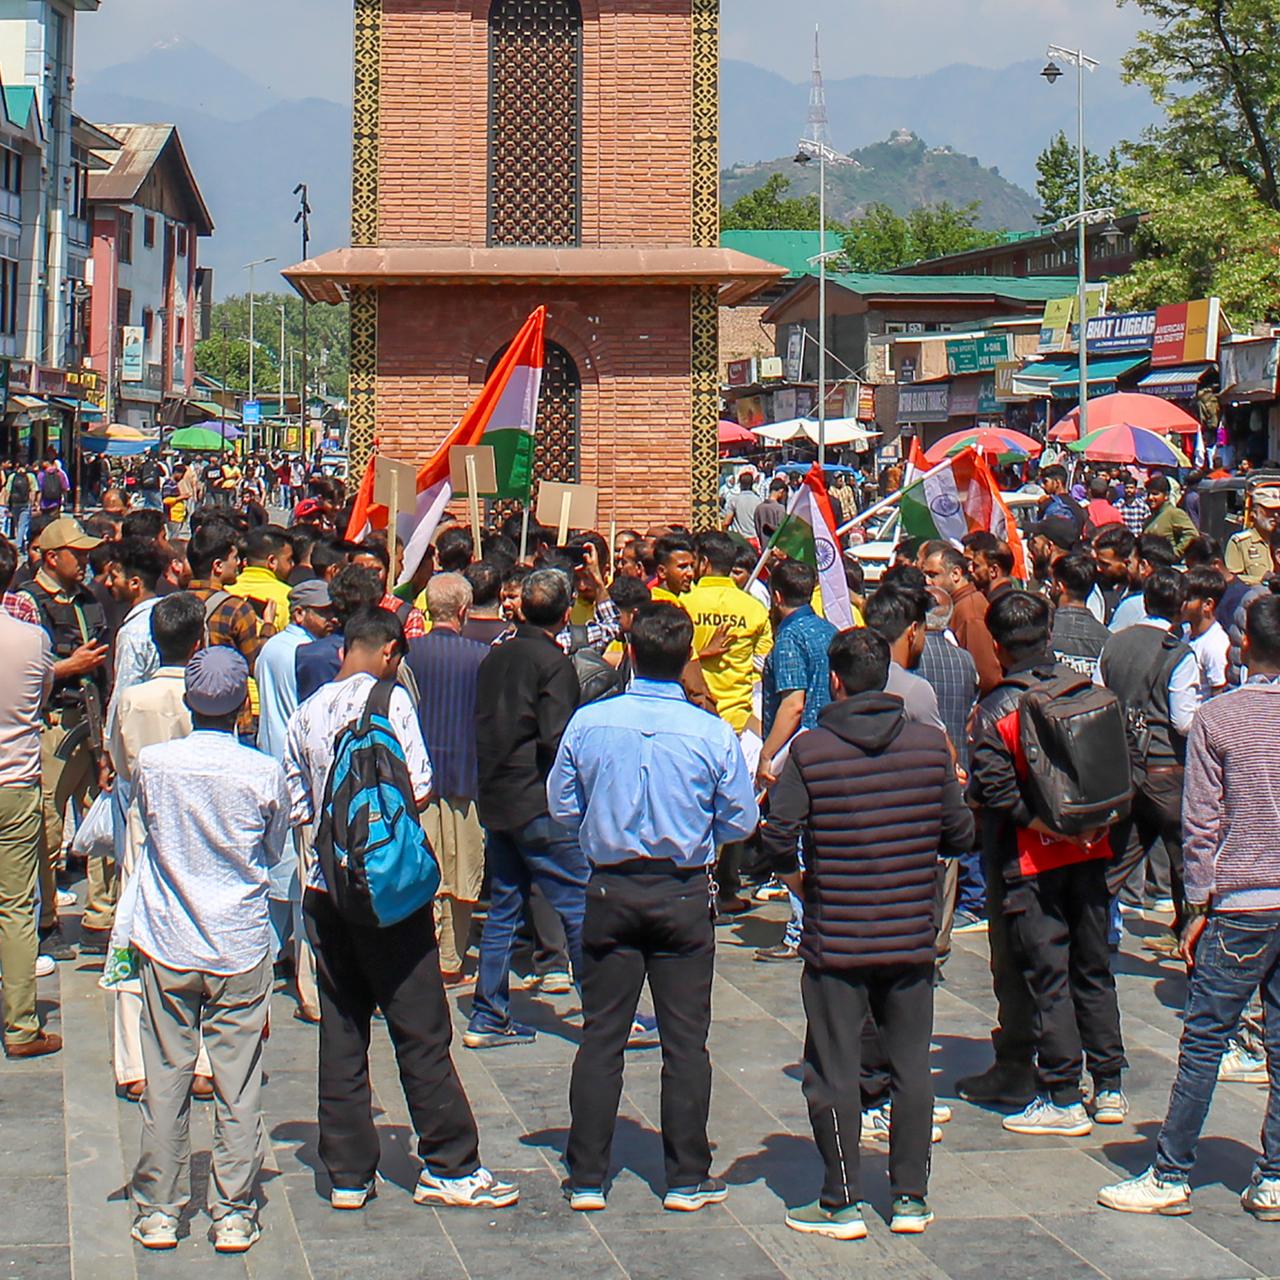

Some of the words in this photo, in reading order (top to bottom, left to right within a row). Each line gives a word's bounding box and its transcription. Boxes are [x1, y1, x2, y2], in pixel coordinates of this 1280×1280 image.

[1087, 319, 1113, 339] BHAT
[1156, 322, 1185, 334] AMERICAN
[1154, 332, 1185, 344] TOURISTER
